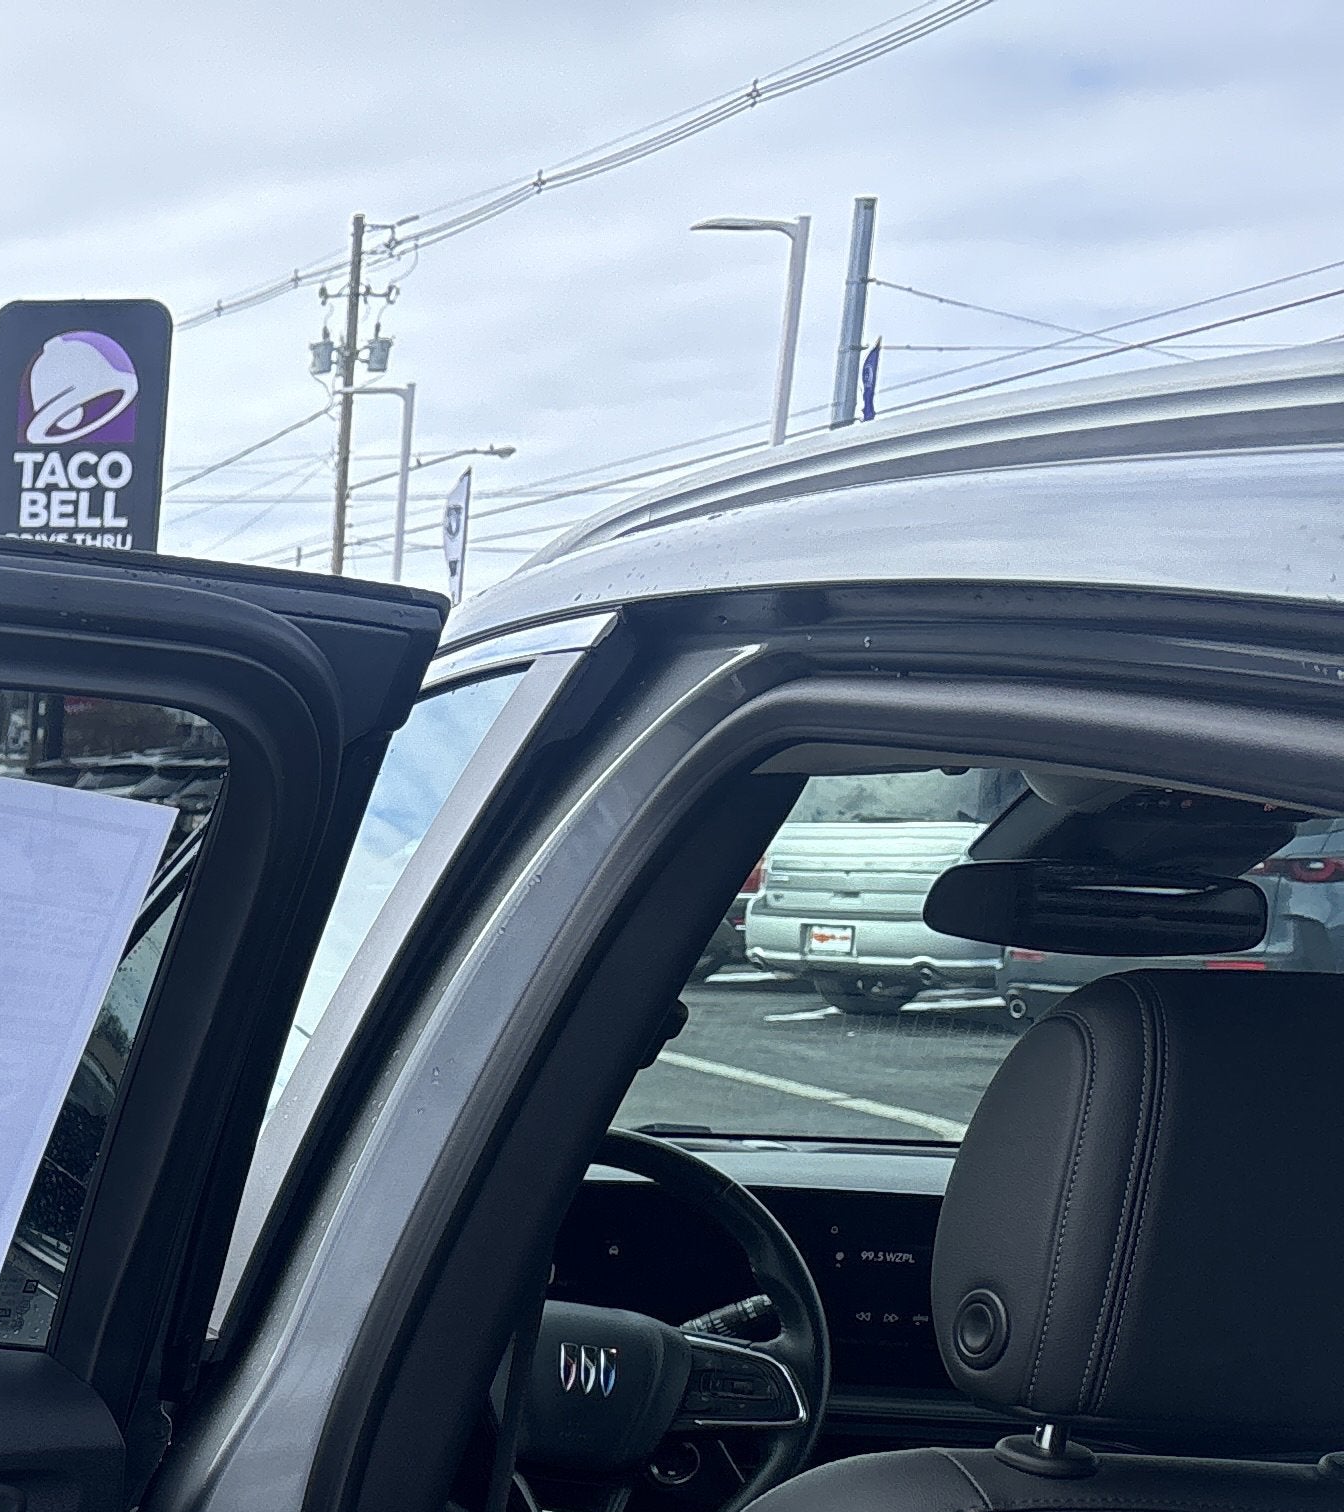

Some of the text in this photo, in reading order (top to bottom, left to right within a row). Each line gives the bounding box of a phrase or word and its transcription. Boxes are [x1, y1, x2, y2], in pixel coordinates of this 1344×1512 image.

[13, 450, 133, 489] TACO
[19, 490, 129, 528] BELL
[72, 532, 133, 550] THRU
[860, 1250, 916, 1264] 99.5 WZPL
